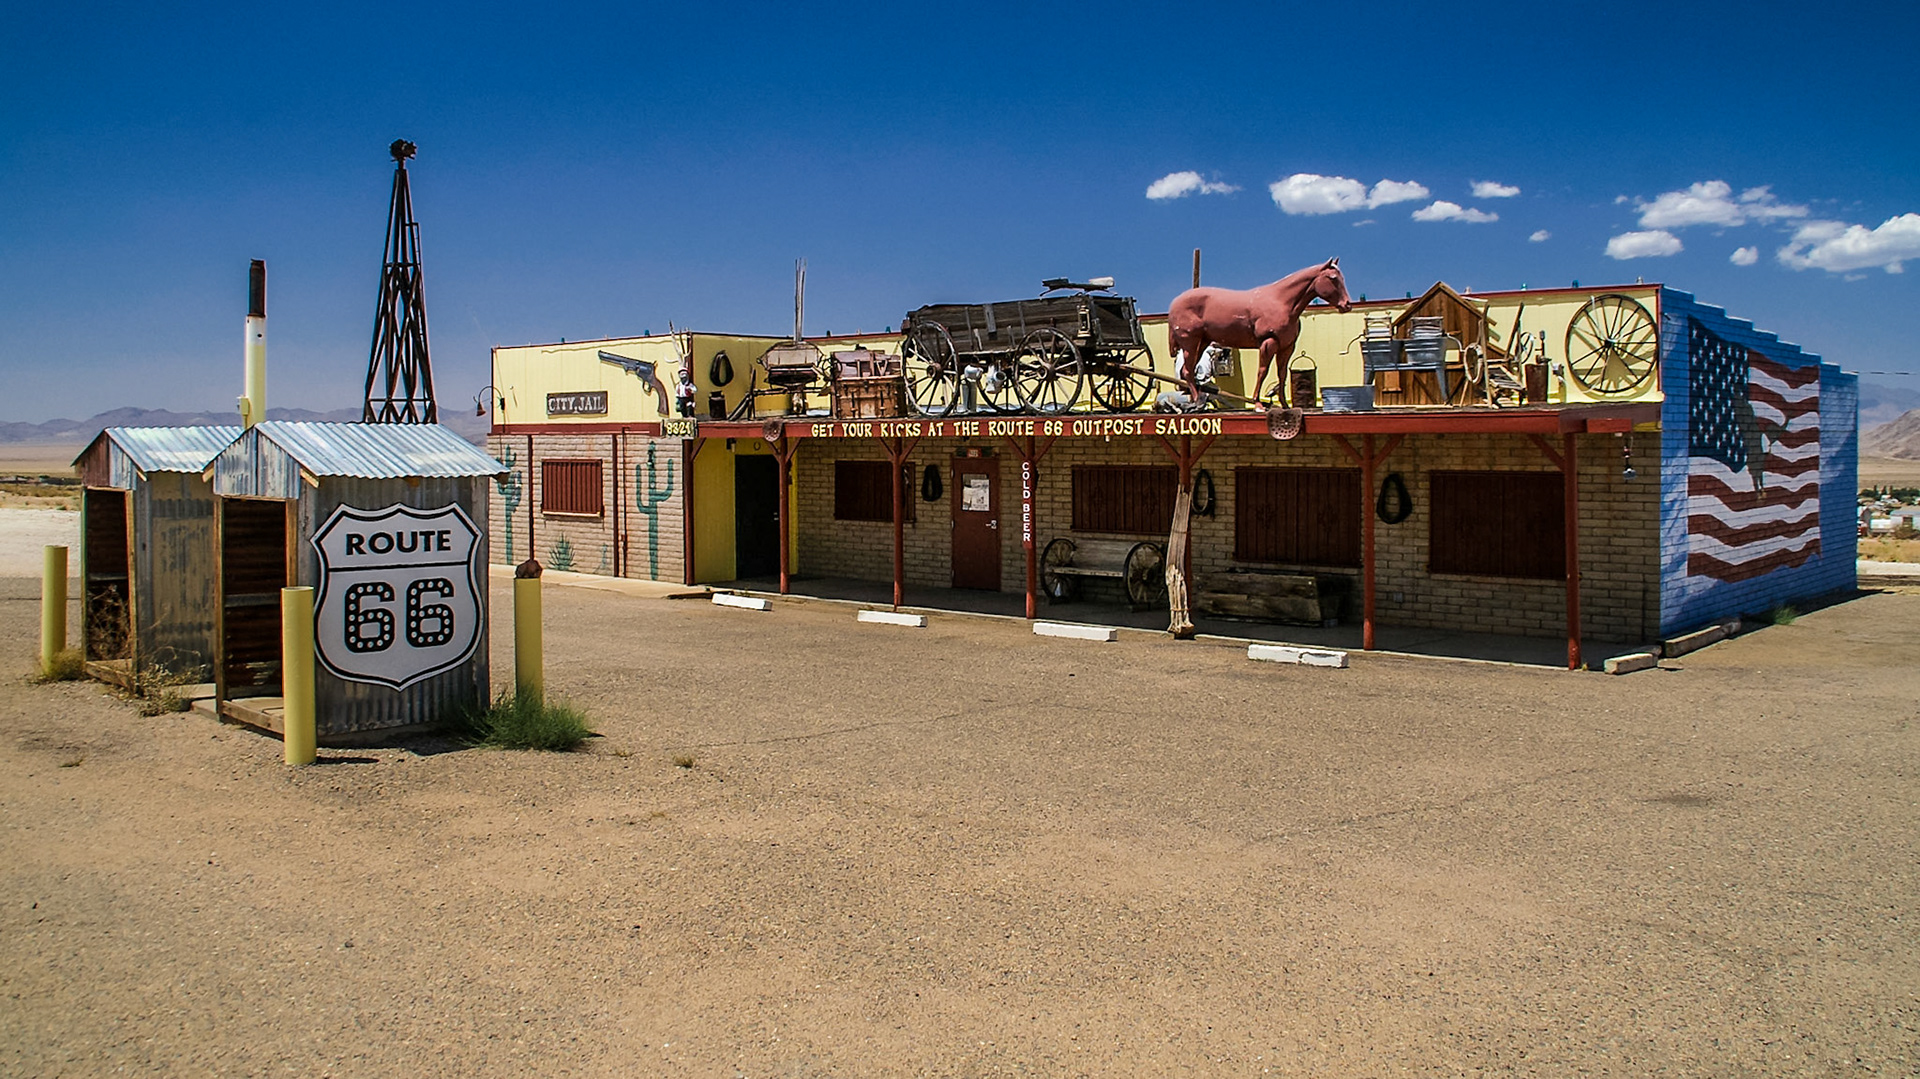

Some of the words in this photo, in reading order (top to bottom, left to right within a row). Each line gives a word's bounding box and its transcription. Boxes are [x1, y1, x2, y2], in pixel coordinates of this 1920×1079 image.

[548, 397, 576, 411] CITY
[578, 396, 604, 411] JAIL
[811, 423, 835, 438] GET
[842, 423, 873, 438] YOUR
[880, 422, 922, 438] KICKS
[928, 421, 944, 437] AT
[953, 421, 980, 437] THE
[988, 420, 1035, 437] ROUTE
[1043, 420, 1063, 436] 66
[1072, 419, 1144, 436] OUTPOST
[1155, 418, 1223, 435] SALOON
[1022, 462, 1031, 499] COLD
[1022, 503, 1031, 542] BEER
[345, 529, 451, 556] ROUTE
[344, 577, 454, 653] 66
